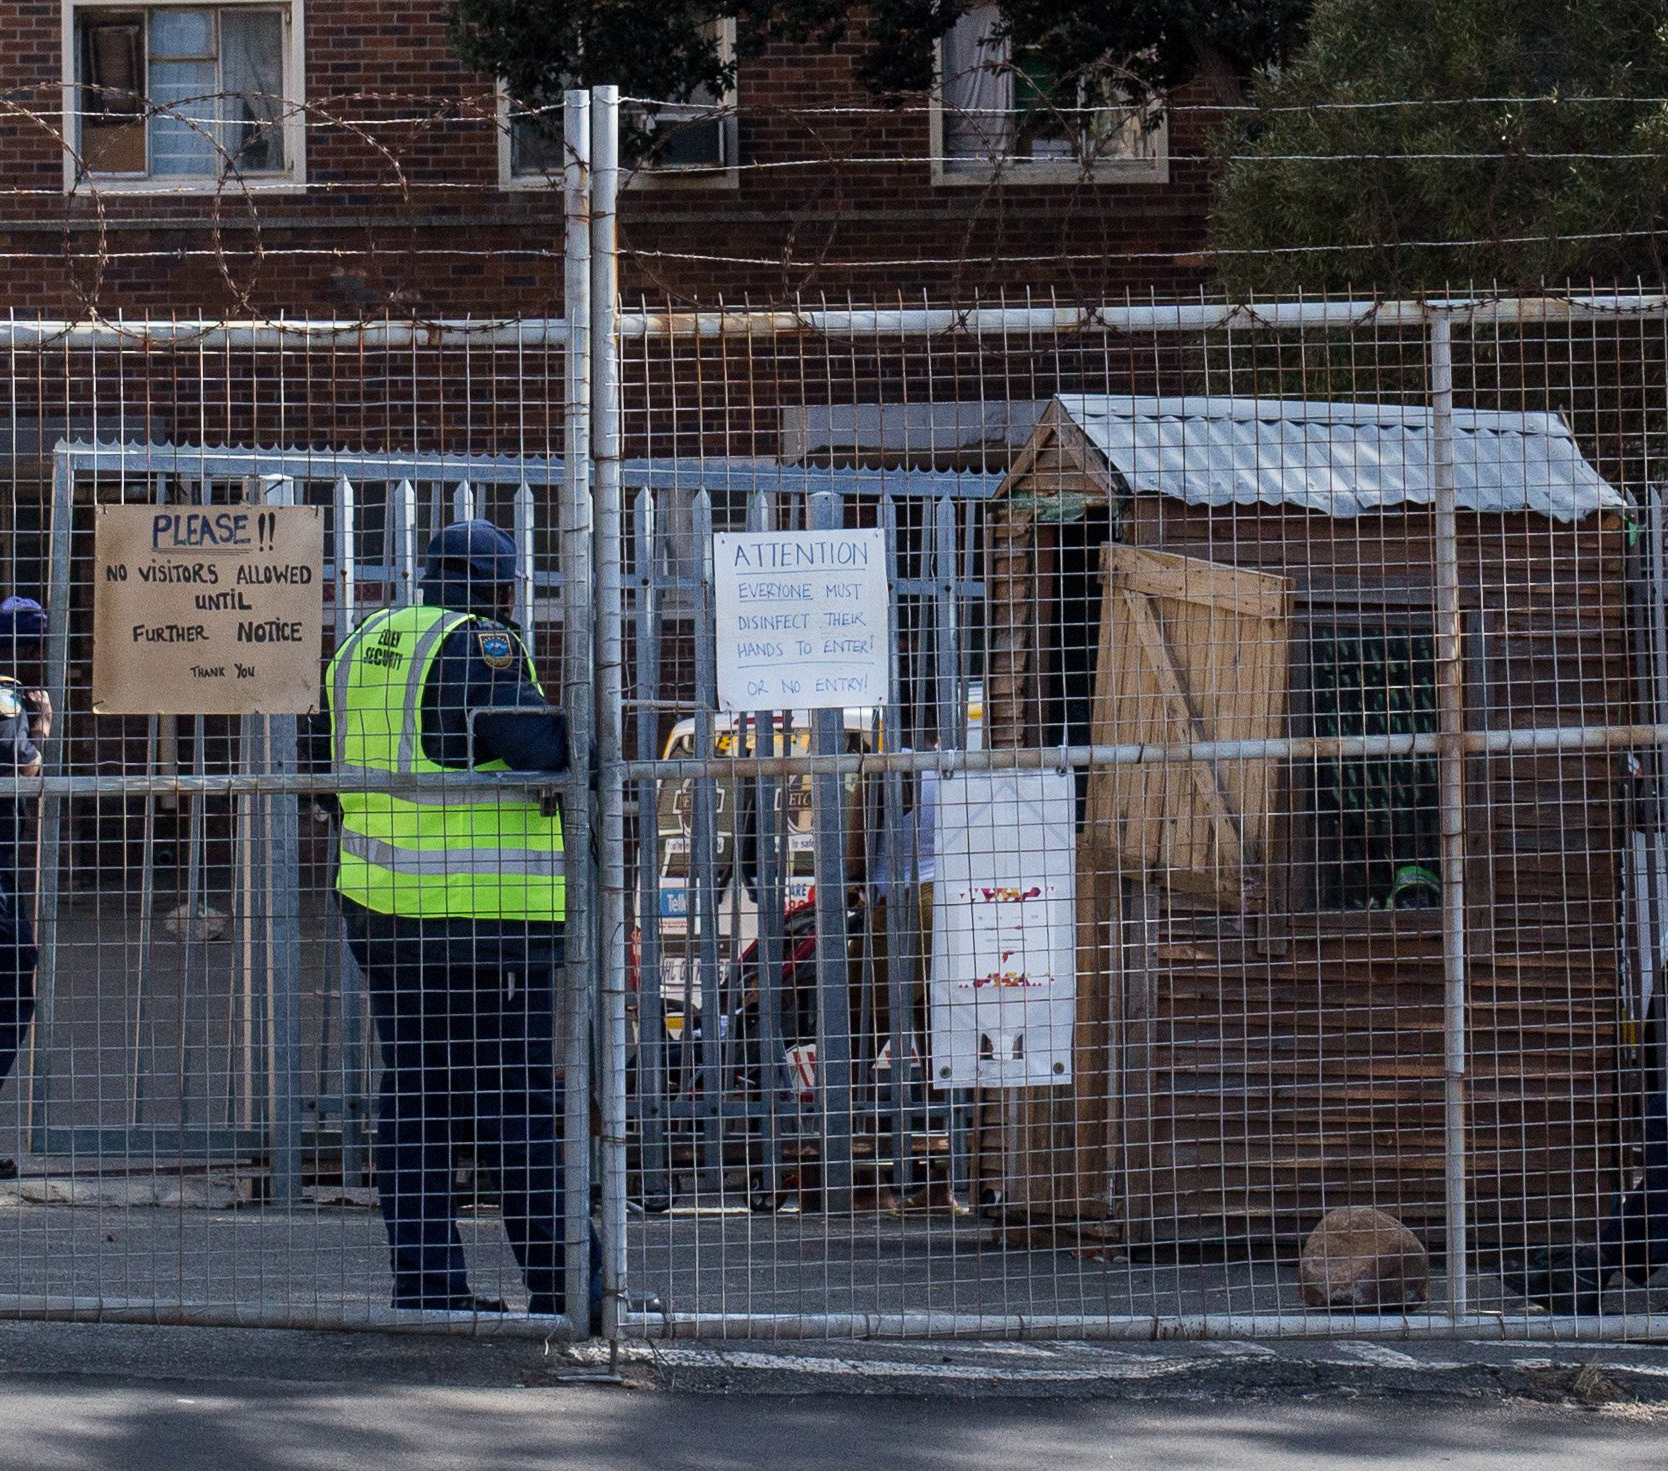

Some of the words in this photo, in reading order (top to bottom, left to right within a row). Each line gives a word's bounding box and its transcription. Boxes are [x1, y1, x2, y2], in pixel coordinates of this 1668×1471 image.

[152, 513, 251, 548] PLEASE
[734, 542, 868, 567] ATTENTION
[106, 564, 128, 582] NO
[236, 565, 312, 585] ALLOWED
[738, 582, 813, 599] EVERYONE
[826, 583, 862, 600] MUST
[738, 613, 810, 630] DISINFECT
[825, 612, 867, 627] THEIR
[133, 624, 209, 642] FURTHER
[737, 642, 783, 658] HANDS
[796, 640, 812, 655] TO
[824, 635, 873, 654] ENTER!
[190, 666, 225, 678] THANK
[747, 681, 769, 696] OR
[783, 681, 801, 694] NO
[816, 674, 868, 694] ENTRY!
